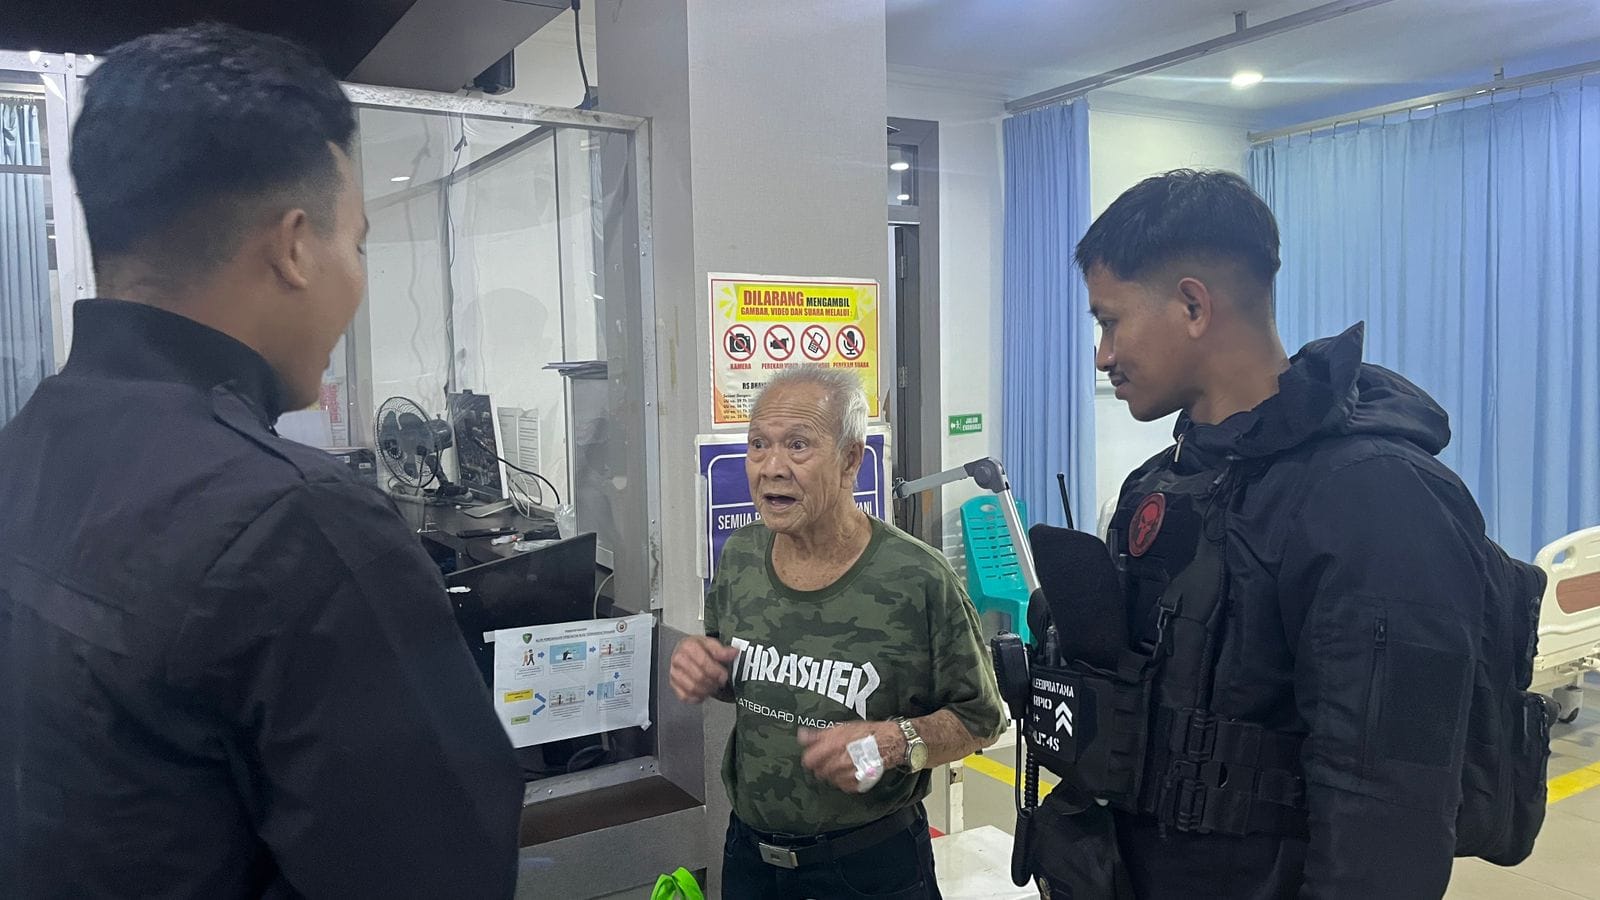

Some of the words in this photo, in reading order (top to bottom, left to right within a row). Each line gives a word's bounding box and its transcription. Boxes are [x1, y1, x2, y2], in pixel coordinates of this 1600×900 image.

[743, 290, 804, 306] DILARANG
[806, 297, 850, 308] MENGAMBIL
[741, 306, 770, 316] GAMBAR,
[770, 307, 789, 316] VIDEO
[790, 307, 803, 316] DAN
[804, 307, 824, 316] SUARA
[825, 308, 850, 317] MELALUI
[718, 513, 752, 530] SEMUA
[731, 637, 880, 720] THRASHER
[736, 697, 795, 723] ATEBOARD
